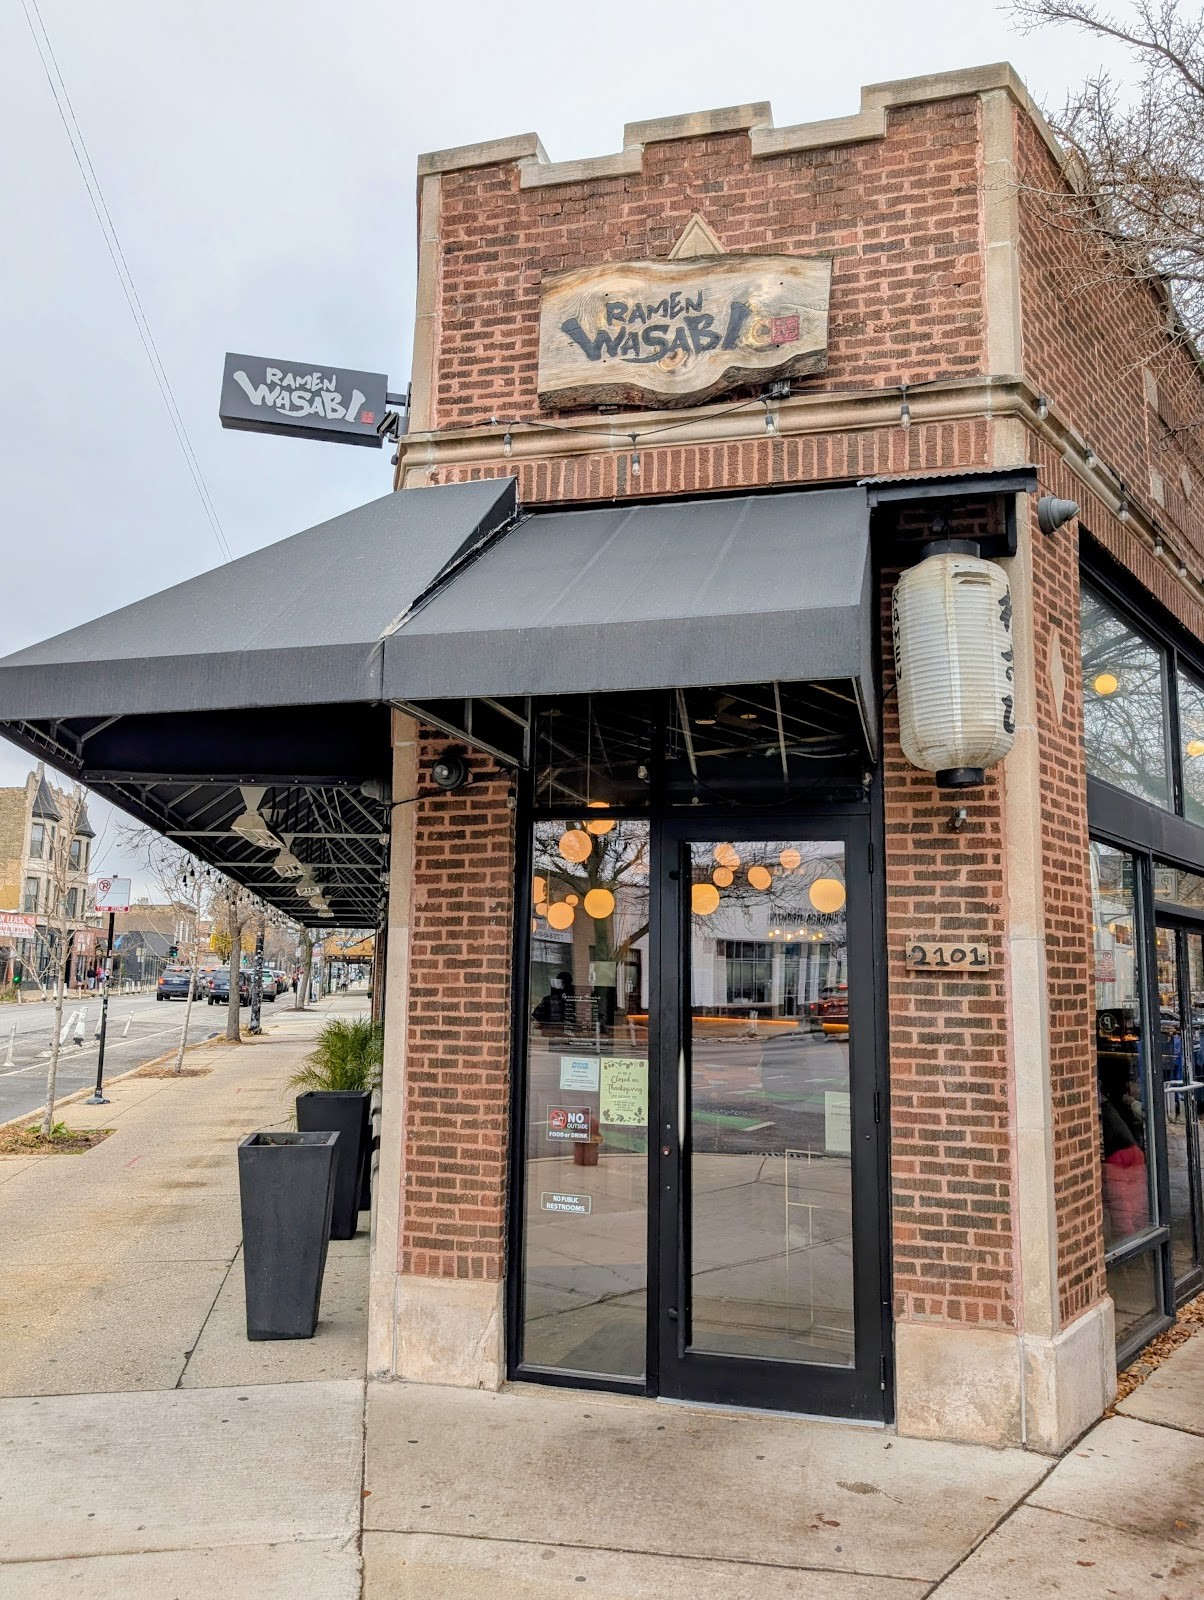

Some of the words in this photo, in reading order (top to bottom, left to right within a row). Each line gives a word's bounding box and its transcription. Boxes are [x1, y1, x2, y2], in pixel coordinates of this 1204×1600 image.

[605, 289, 704, 326] RAMEN
[561, 300, 752, 364] WASABI
[266, 367, 337, 392] RAMEN
[233, 370, 366, 423] WASABI
[911, 945, 986, 967] 2101
[611, 1075, 631, 1084] Closed
[607, 1083, 643, 1095] Thanksgiving
[568, 1113, 584, 1123] NO
[546, 1203, 585, 1211] RESTROOMS
[561, 1196, 579, 1204] PUBLIC
